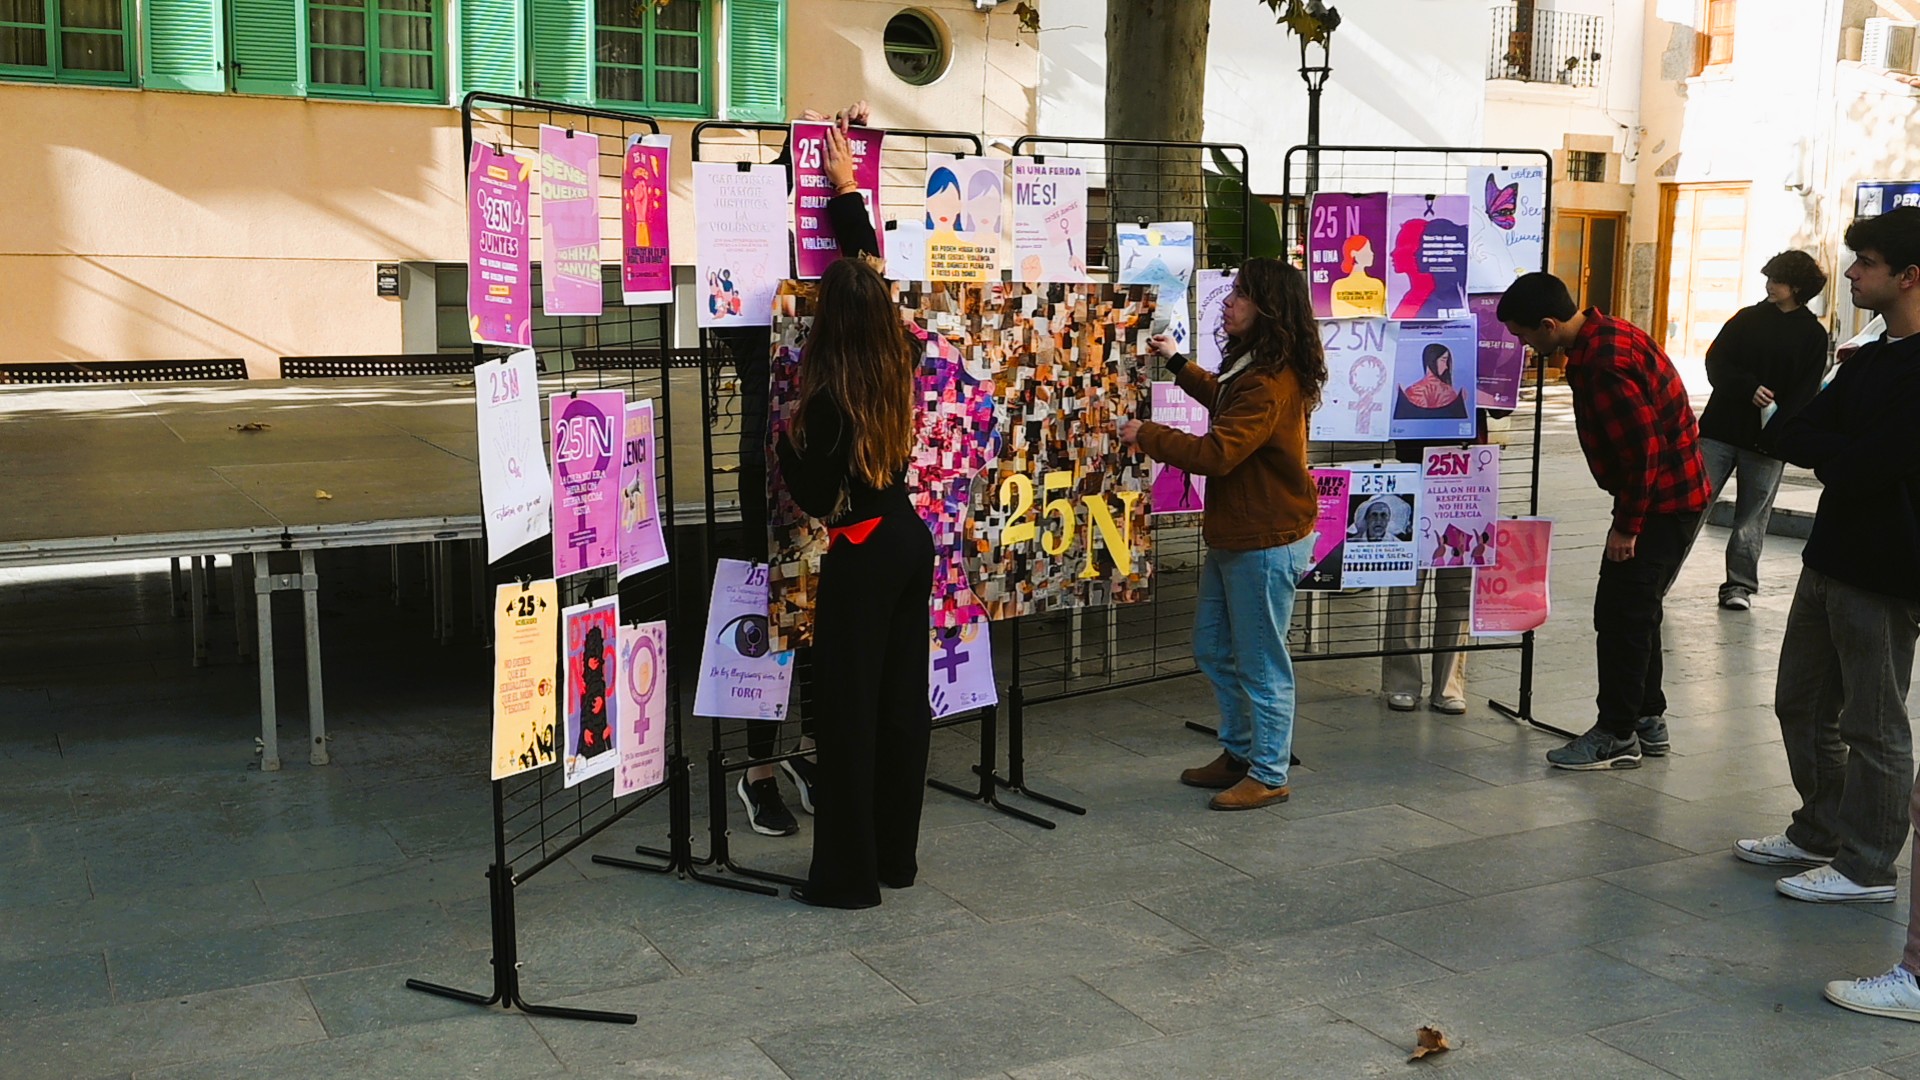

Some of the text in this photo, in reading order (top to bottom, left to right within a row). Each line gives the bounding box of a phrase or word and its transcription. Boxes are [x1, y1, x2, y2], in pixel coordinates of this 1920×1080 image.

[798, 138, 821, 169] 25
[541, 153, 588, 185] SENSE
[1016, 166, 1081, 176] NI UNA FERIDA
[1017, 177, 1056, 206] MÉS!
[485, 197, 512, 232] 25N
[1313, 206, 1360, 238] 25 N
[480, 231, 519, 257] JUNTES
[1322, 250, 1338, 263] UNA
[556, 261, 602, 281] CANVIS
[1313, 268, 1329, 284] MÉS
[489, 368, 521, 403] 25N
[1152, 407, 1203, 424] AMINAR, NO
[556, 416, 616, 464] 25N
[1426, 452, 1471, 476] 25N
[1317, 476, 1347, 488] ANYS,
[1427, 486, 1448, 494] ALLÀ
[1434, 510, 1482, 518] VIOLÈNCIA
[1466, 502, 1478, 510] HA
[1000, 470, 1140, 578] 25N
[745, 568, 768, 587] 25
[1476, 577, 1508, 595] NO
[518, 595, 536, 617] 25
[731, 686, 762, 700] FORÇA
